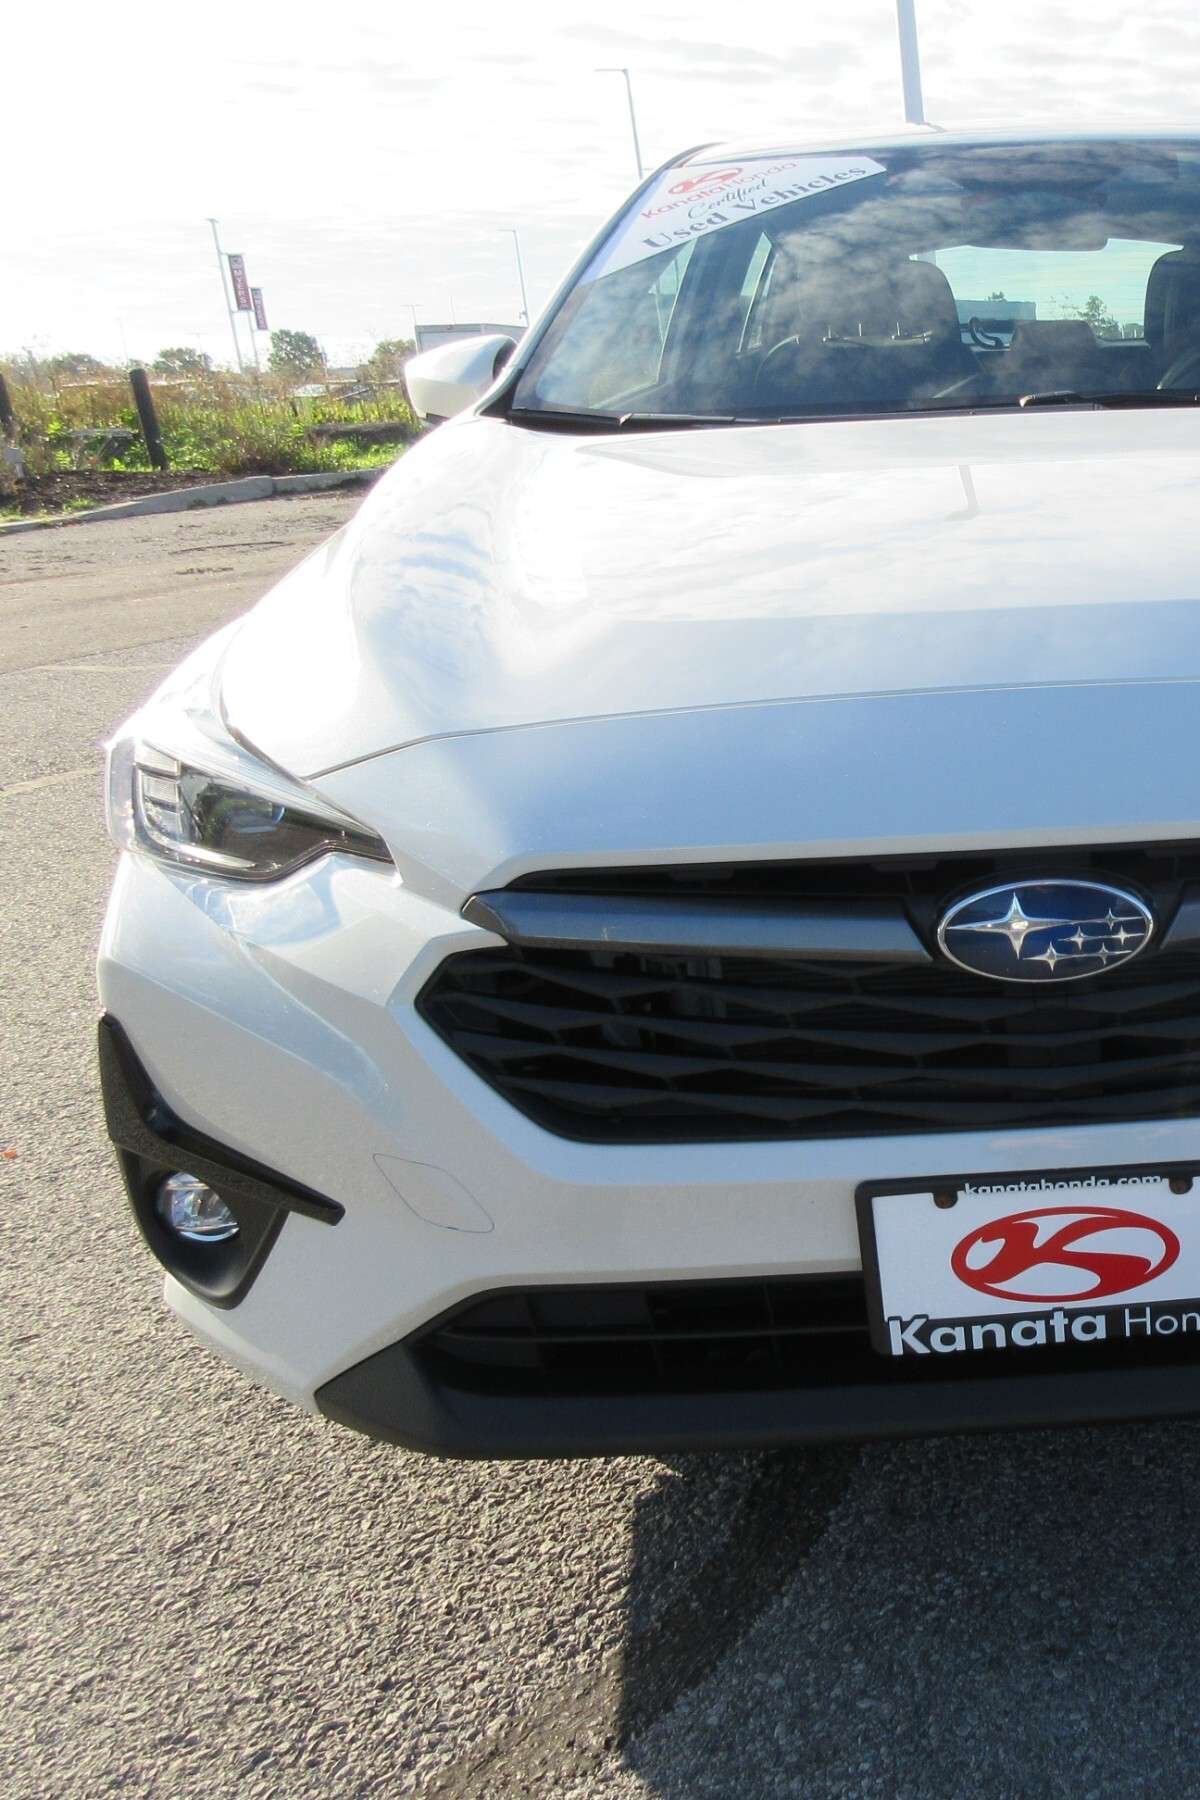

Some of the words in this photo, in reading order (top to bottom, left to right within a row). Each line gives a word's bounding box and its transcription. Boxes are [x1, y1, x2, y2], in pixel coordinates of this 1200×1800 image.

[643, 211, 729, 248] Used
[731, 167, 867, 212] Vehicles
[687, 178, 766, 220] Certified
[964, 1174, 1161, 1195] kanatahonda.com
[888, 1310, 1107, 1356] Kanata
